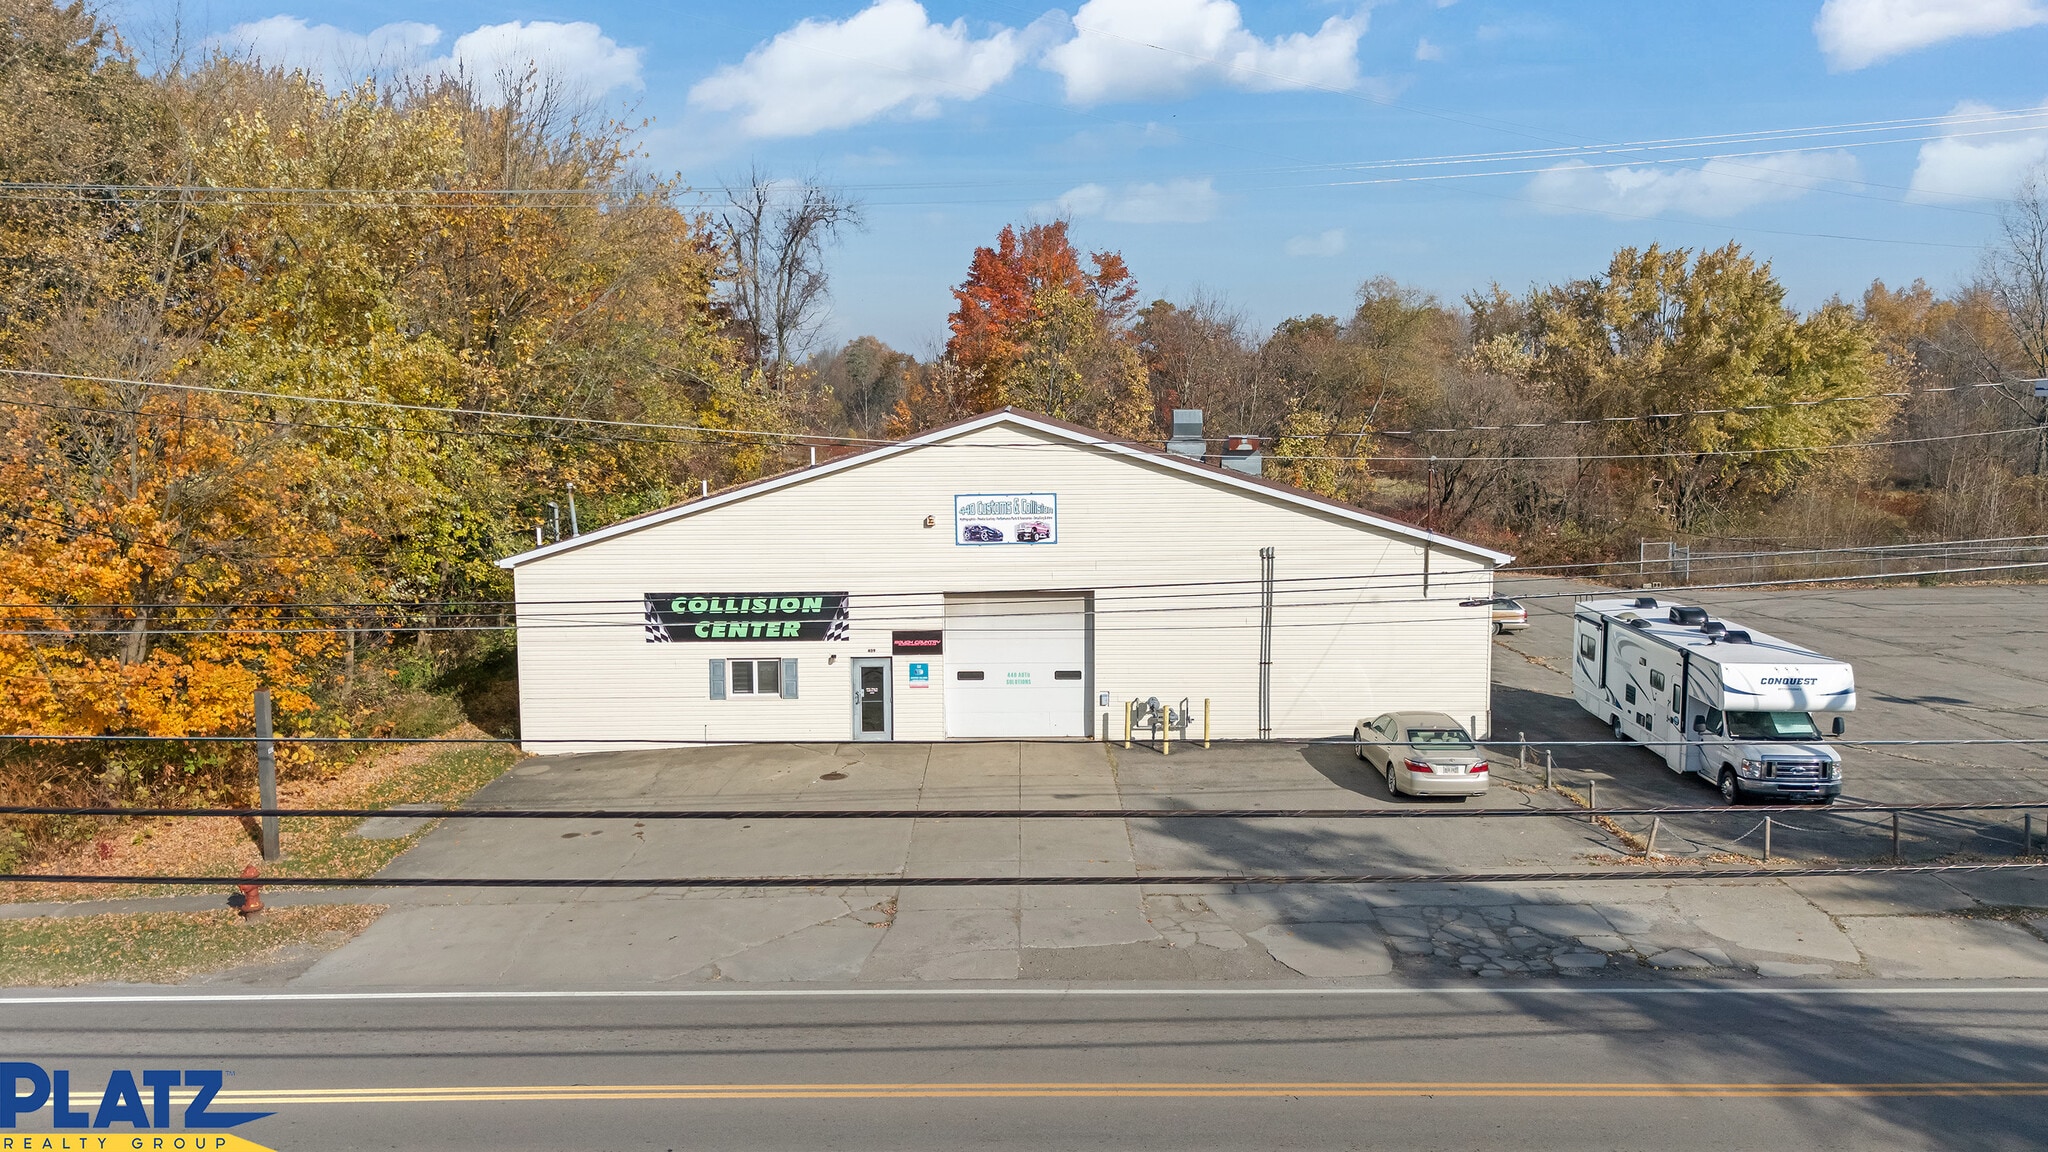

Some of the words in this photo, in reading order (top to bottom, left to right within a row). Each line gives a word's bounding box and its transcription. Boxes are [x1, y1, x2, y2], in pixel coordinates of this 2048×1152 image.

[977, 500, 1012, 516] Customs
[1013, 498, 1020, 515] &
[671, 596, 823, 615] COLLISION
[694, 621, 802, 638] CENTER
[1760, 677, 1818, 686] CONQUEST
